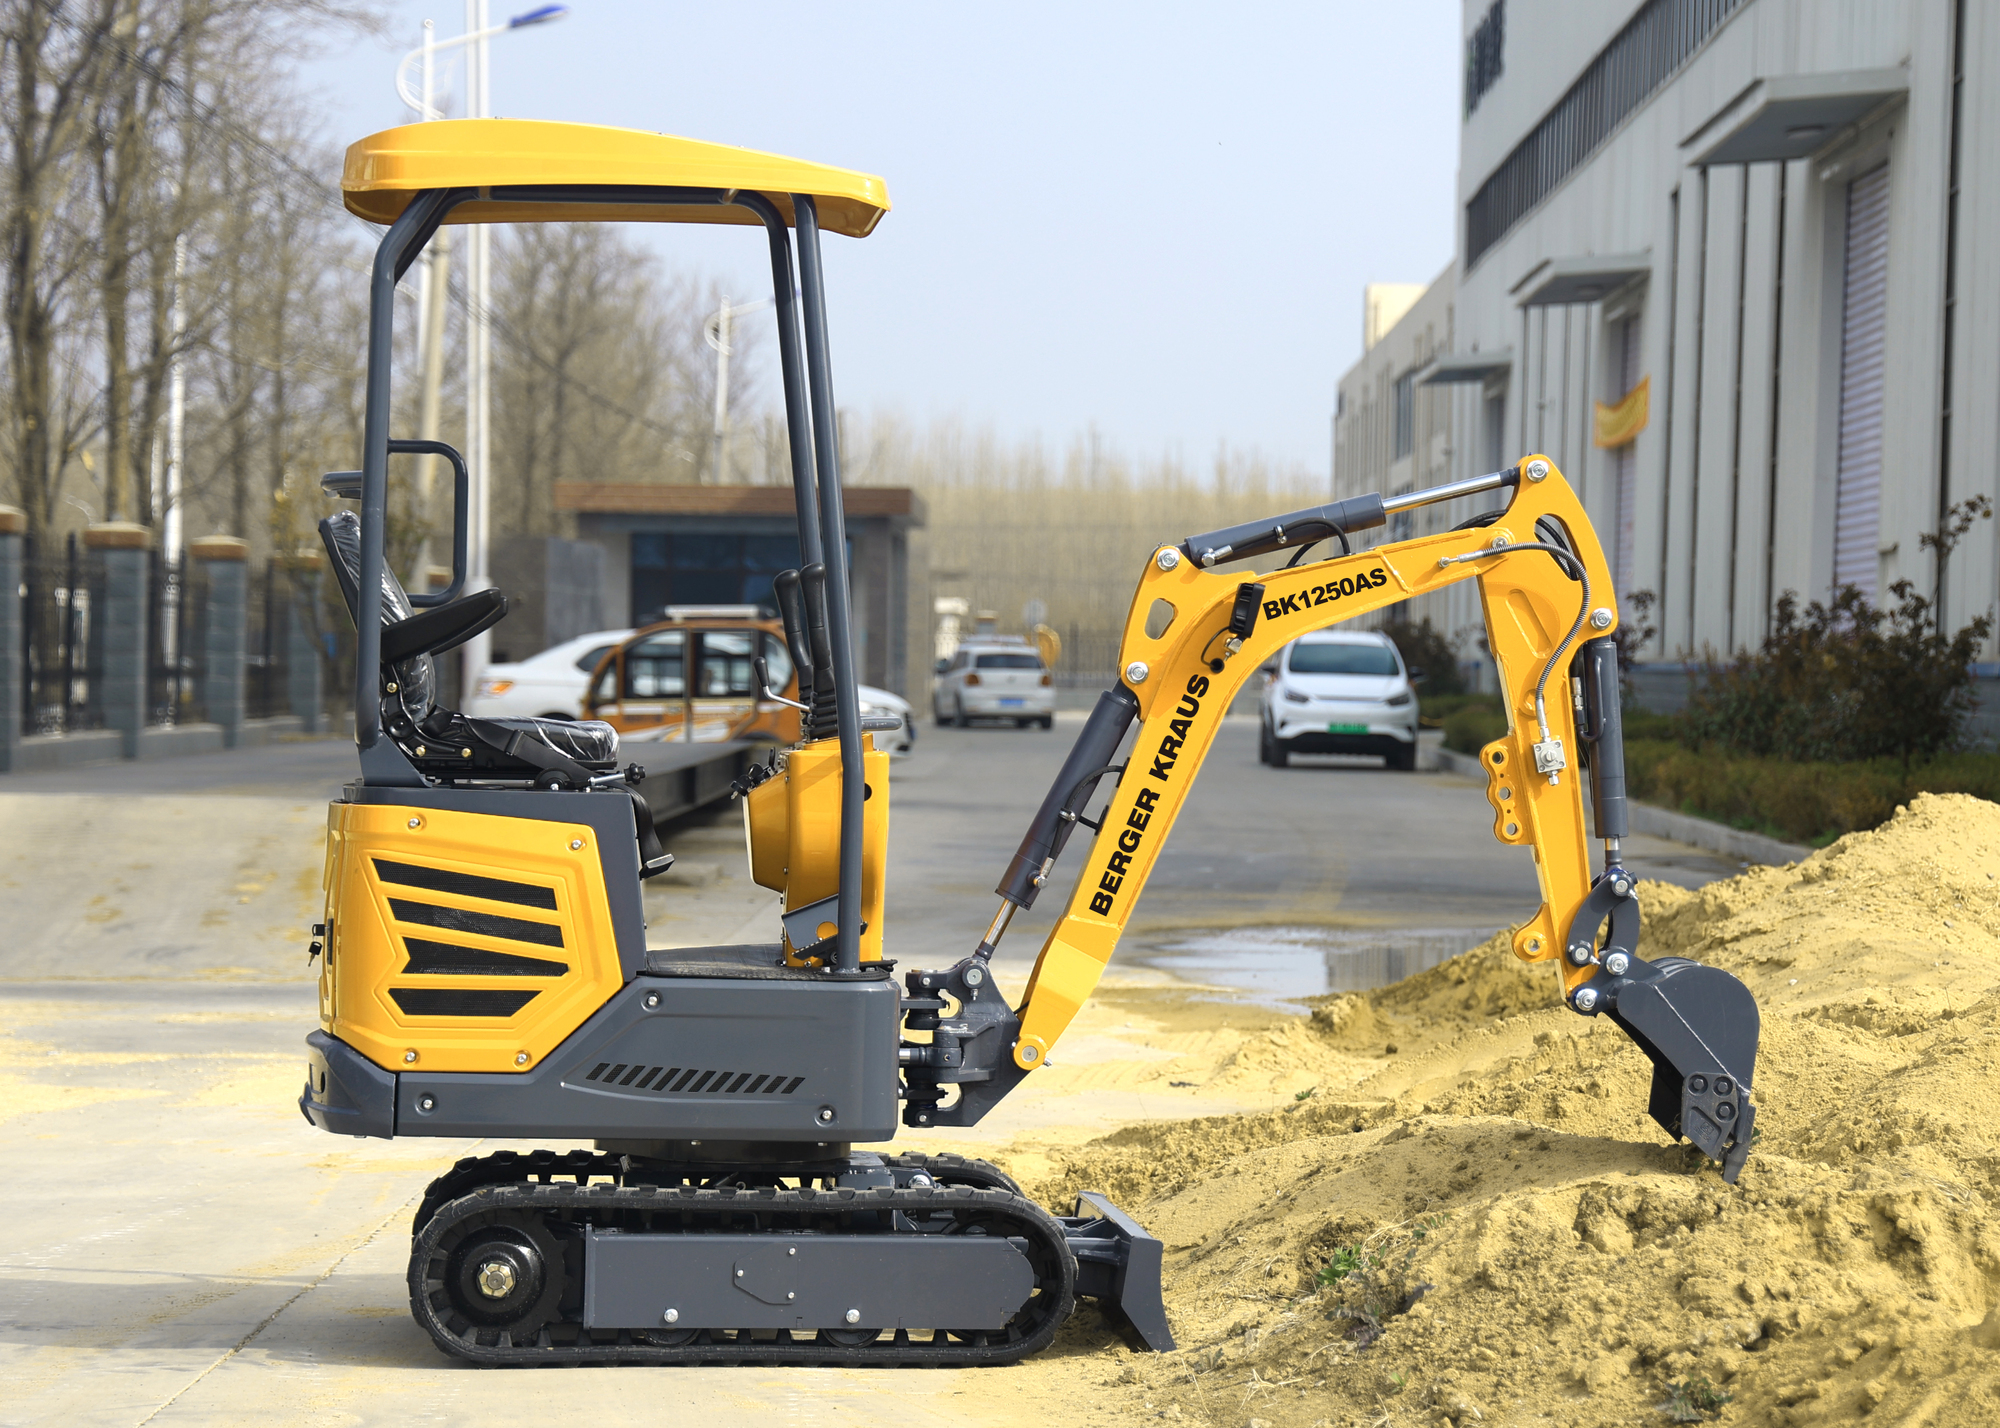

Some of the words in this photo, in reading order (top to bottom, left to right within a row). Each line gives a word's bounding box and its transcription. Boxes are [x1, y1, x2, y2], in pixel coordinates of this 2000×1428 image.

[1263, 569, 1388, 620] BK1250AS
[1089, 788, 1160, 916] BERGER
[1149, 674, 1209, 782] KRAUS
